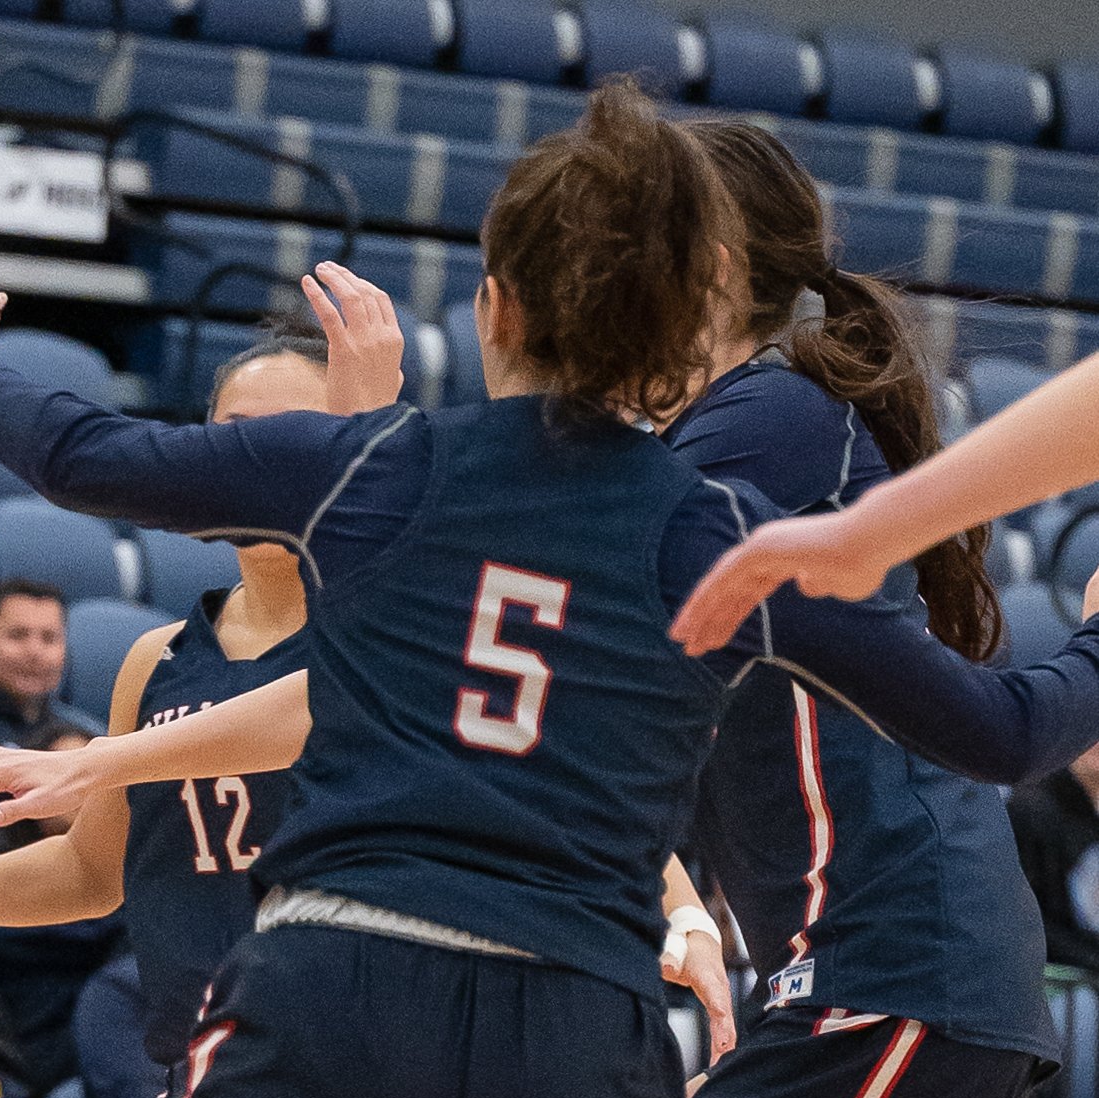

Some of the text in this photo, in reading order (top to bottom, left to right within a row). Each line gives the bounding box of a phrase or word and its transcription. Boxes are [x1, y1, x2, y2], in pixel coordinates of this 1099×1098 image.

[453, 560, 572, 757] 5
[181, 775, 262, 874] 12
[788, 976, 803, 994] M
